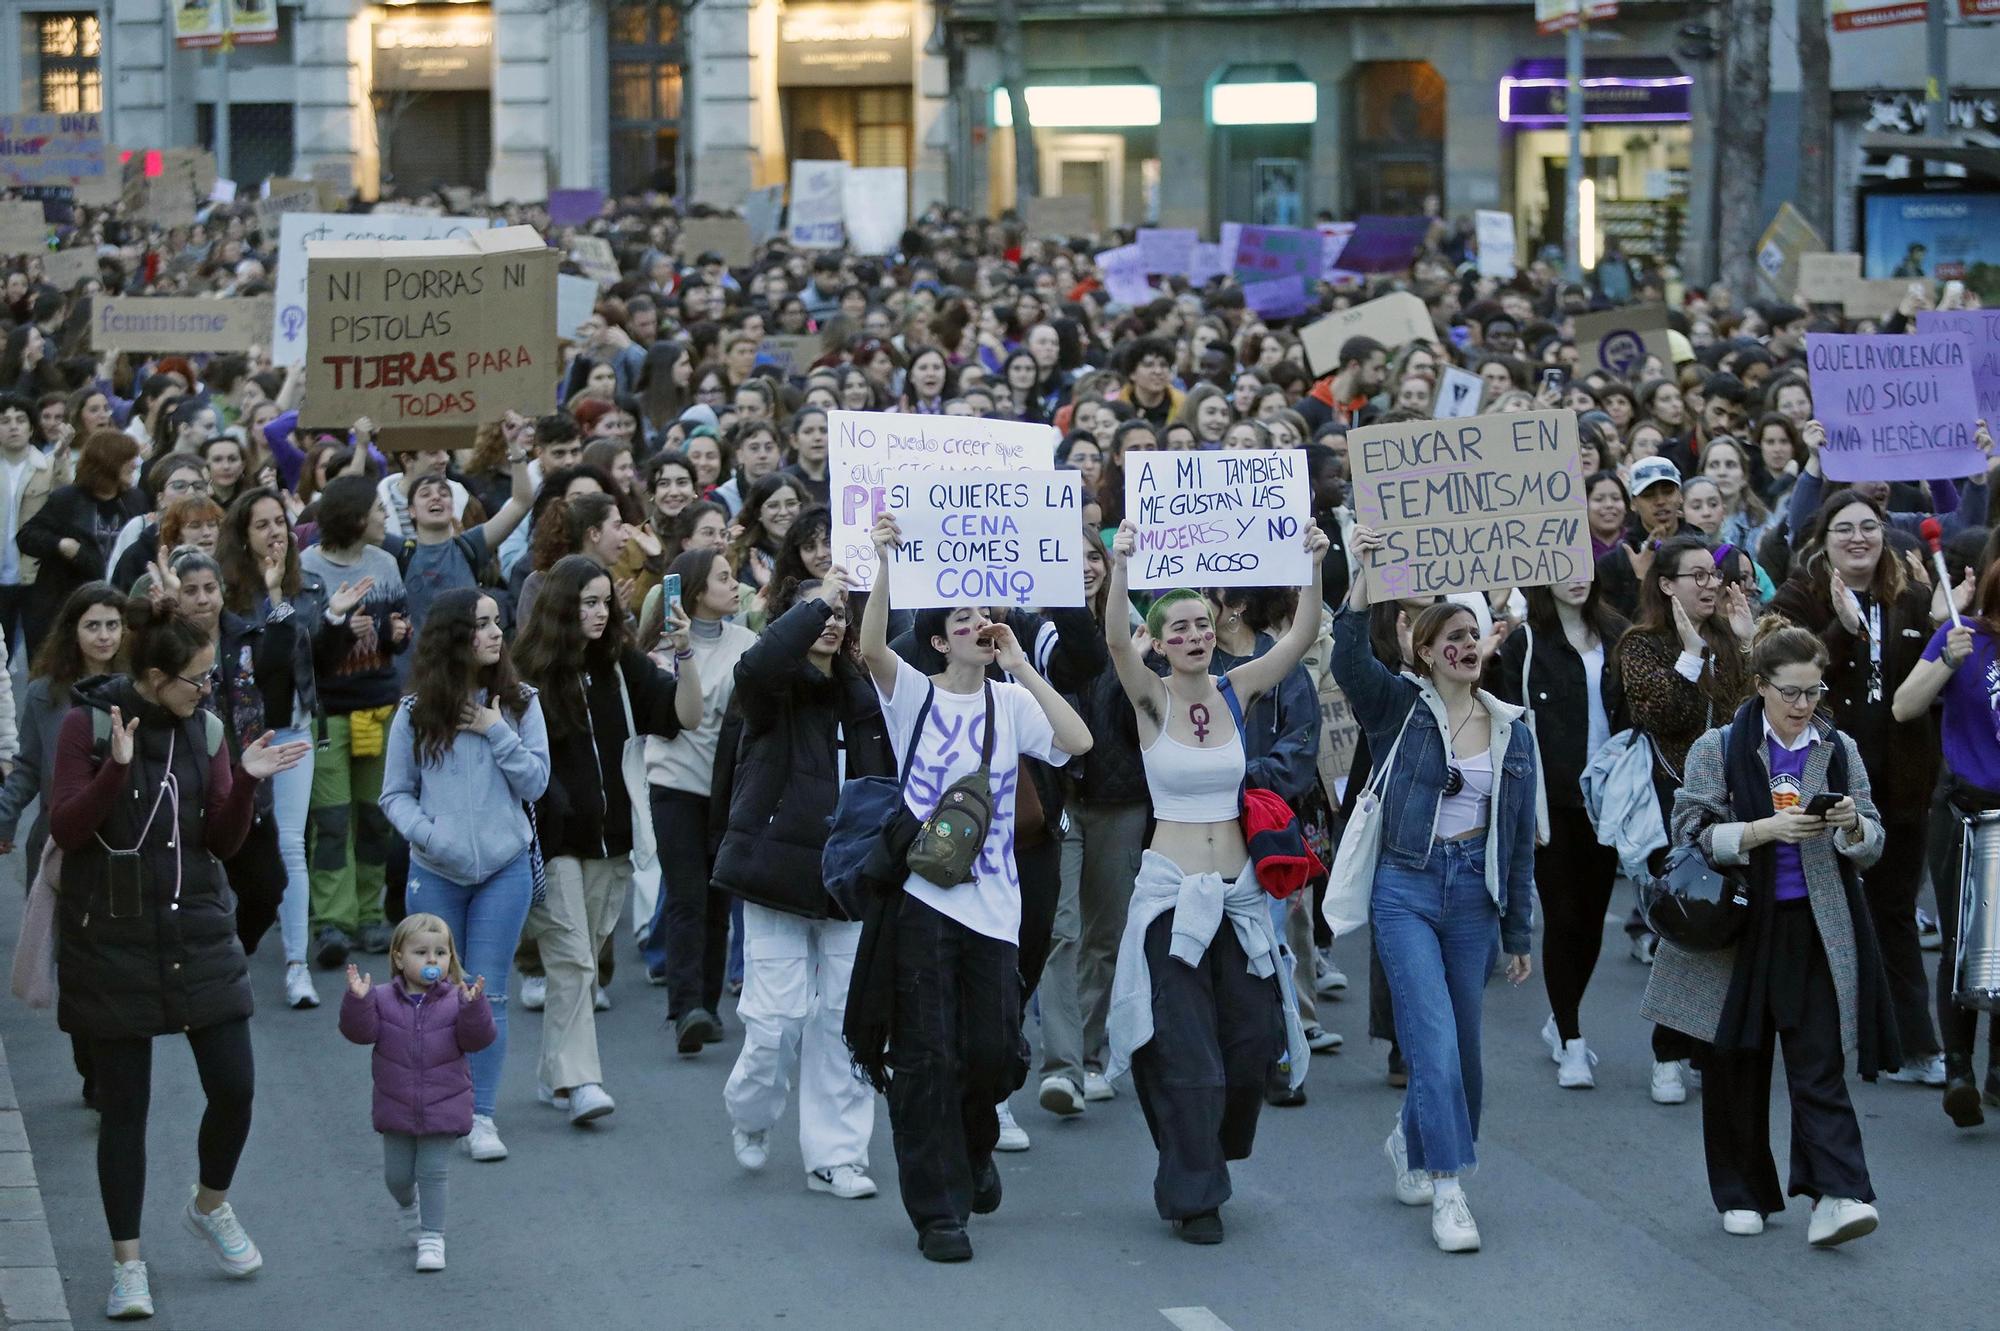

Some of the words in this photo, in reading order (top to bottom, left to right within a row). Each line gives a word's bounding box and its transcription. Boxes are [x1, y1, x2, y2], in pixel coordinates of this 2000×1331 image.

[328, 271, 361, 301] NI
[385, 267, 483, 301] PORRAS
[504, 264, 525, 290] NI
[100, 304, 229, 333] feminisme
[330, 311, 451, 342] PISTOLAS
[323, 351, 457, 389] TIJERAS
[467, 345, 532, 378] PARA
[391, 391, 476, 418] TODAS
[1847, 384, 1875, 413] NO
[887, 429, 938, 460] puedo
[943, 437, 990, 456] creer
[995, 443, 1024, 466] que
[1363, 426, 1482, 473] EDUCAR
[1512, 418, 1558, 452] EN
[1139, 462, 1156, 492] A
[1177, 457, 1202, 488] MI
[1217, 452, 1294, 486] TAMBIÉN
[843, 485, 886, 526] PE
[889, 485, 909, 509] SI
[929, 483, 1028, 510] QUIERES
[1046, 485, 1074, 508] LA
[1139, 495, 1165, 524] ME
[1170, 488, 1243, 516] GUSTAN
[1252, 485, 1286, 510] LAS
[1377, 470, 1571, 520] FEMINISMO
[941, 514, 1019, 536] CENA
[1139, 519, 1229, 551] MUJERES
[1236, 516, 1256, 539] Y
[1268, 516, 1298, 541] NO
[1371, 531, 1409, 568] ES
[1416, 519, 1531, 557] EDUCAR
[1536, 518, 1579, 547] EN
[895, 540, 924, 563] ME
[937, 540, 1019, 563] COMES
[1040, 539, 1069, 562] EL
[1145, 554, 1184, 579] LAS
[1196, 552, 1259, 573] ACOSO
[936, 565, 1034, 603] COÑO
[1408, 550, 1574, 593] IGUALDAD
